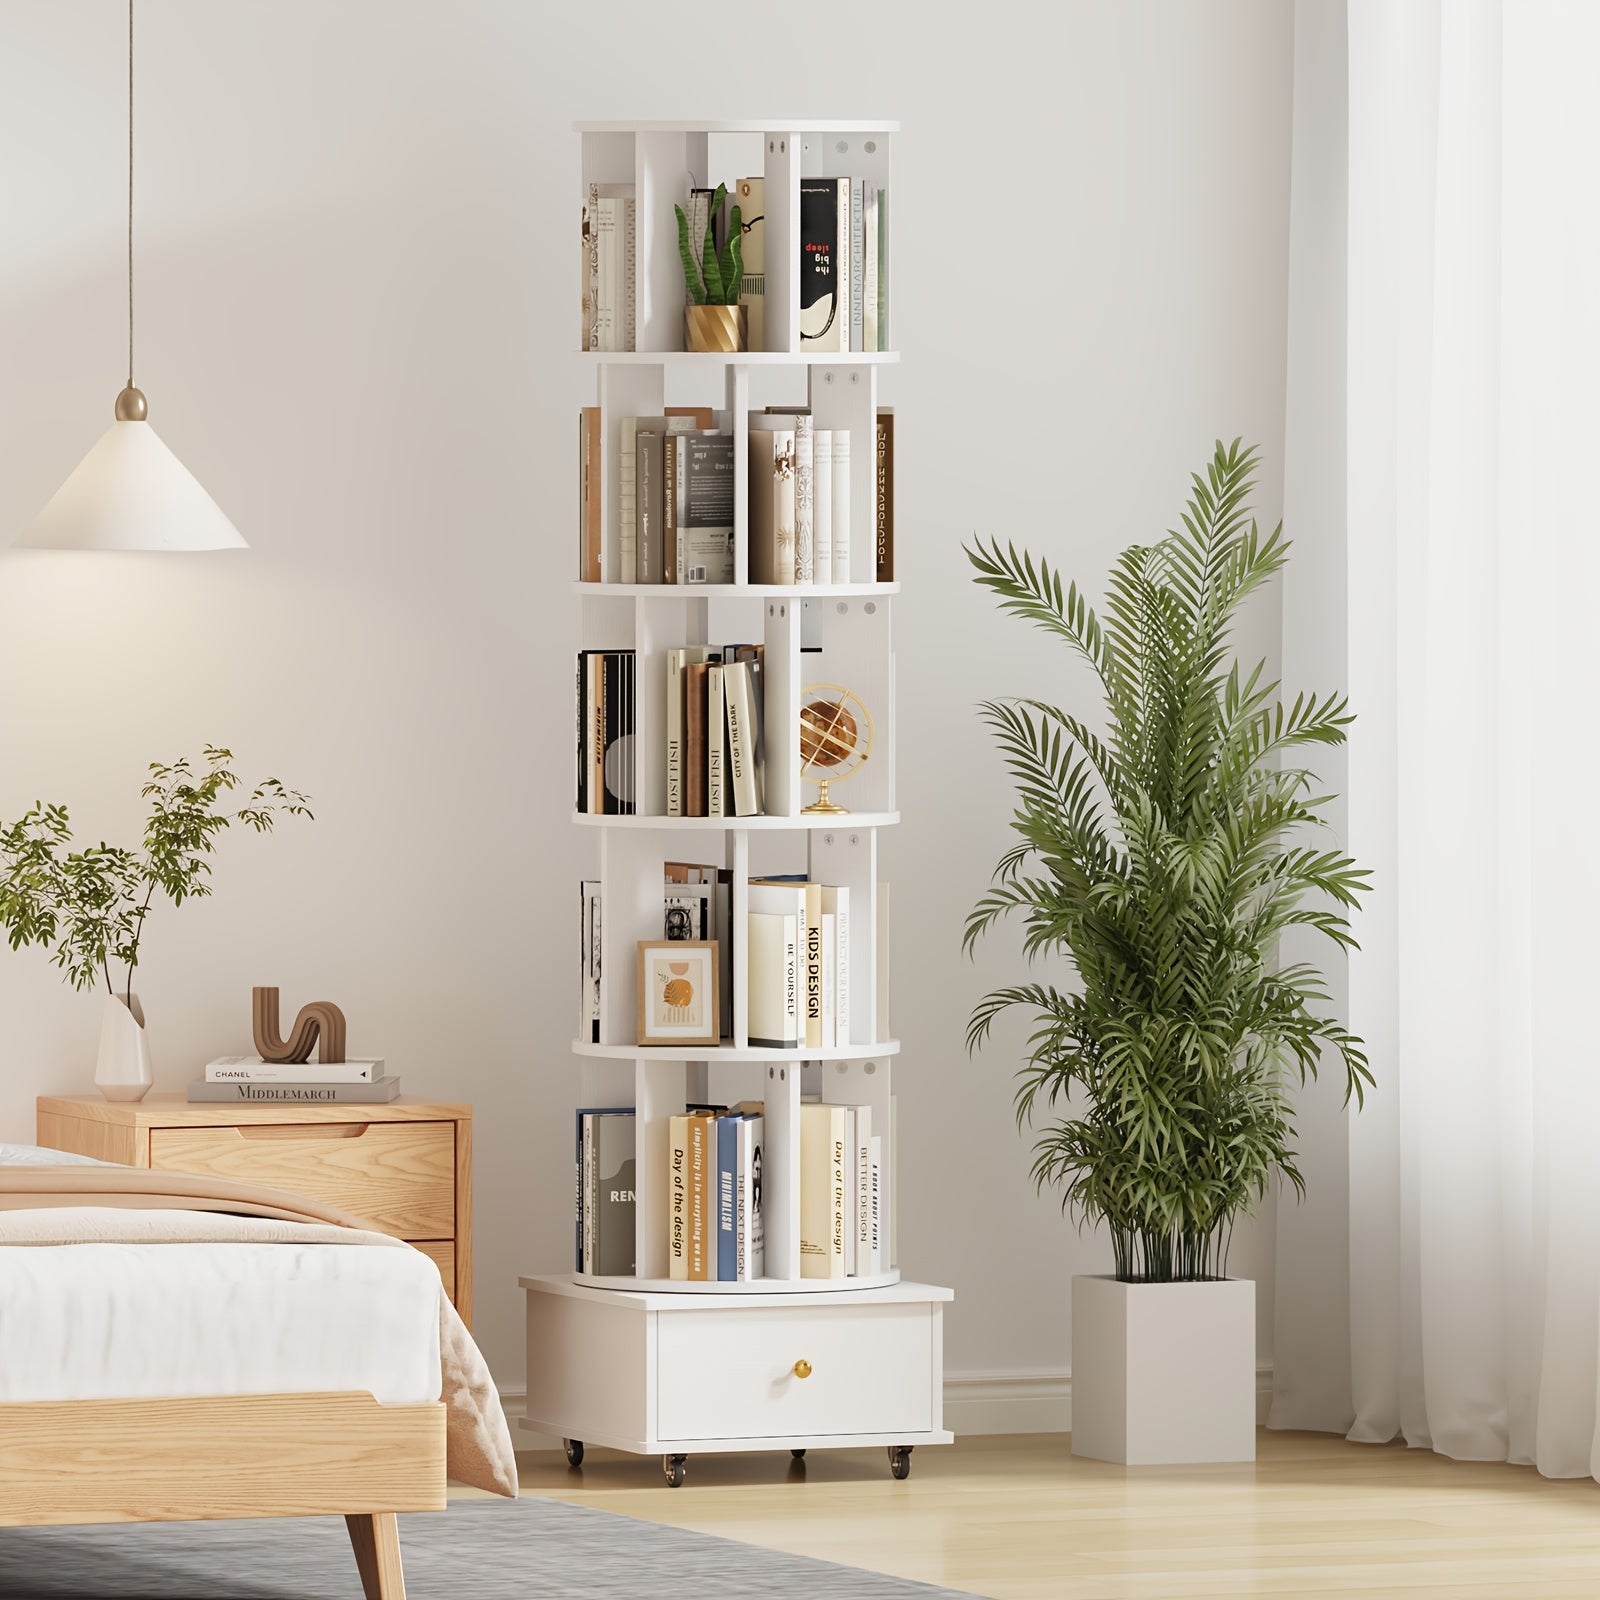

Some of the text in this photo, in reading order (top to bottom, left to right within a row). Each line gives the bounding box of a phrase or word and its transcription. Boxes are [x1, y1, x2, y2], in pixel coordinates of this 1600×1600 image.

[805, 243, 829, 254] sleep
[815, 253, 830, 265] big
[853, 188, 862, 326] INNENARCHITEKTUR
[669, 740, 678, 812] LOST FISH
[729, 704, 742, 778] CITY OF THE DARK
[711, 750, 720, 814] LOST FISH
[787, 943, 795, 1017] BE YOURSELF
[808, 927, 819, 1018] KIDS DESIGN
[672, 1149, 684, 1258] Day of the design
[693, 1127, 702, 1272] simplicity is in everything we see
[721, 1171, 732, 1231] MINIMALISM
[834, 1141, 843, 1254] Day of the design
[860, 1147, 868, 1242] BETTER DESIGN
